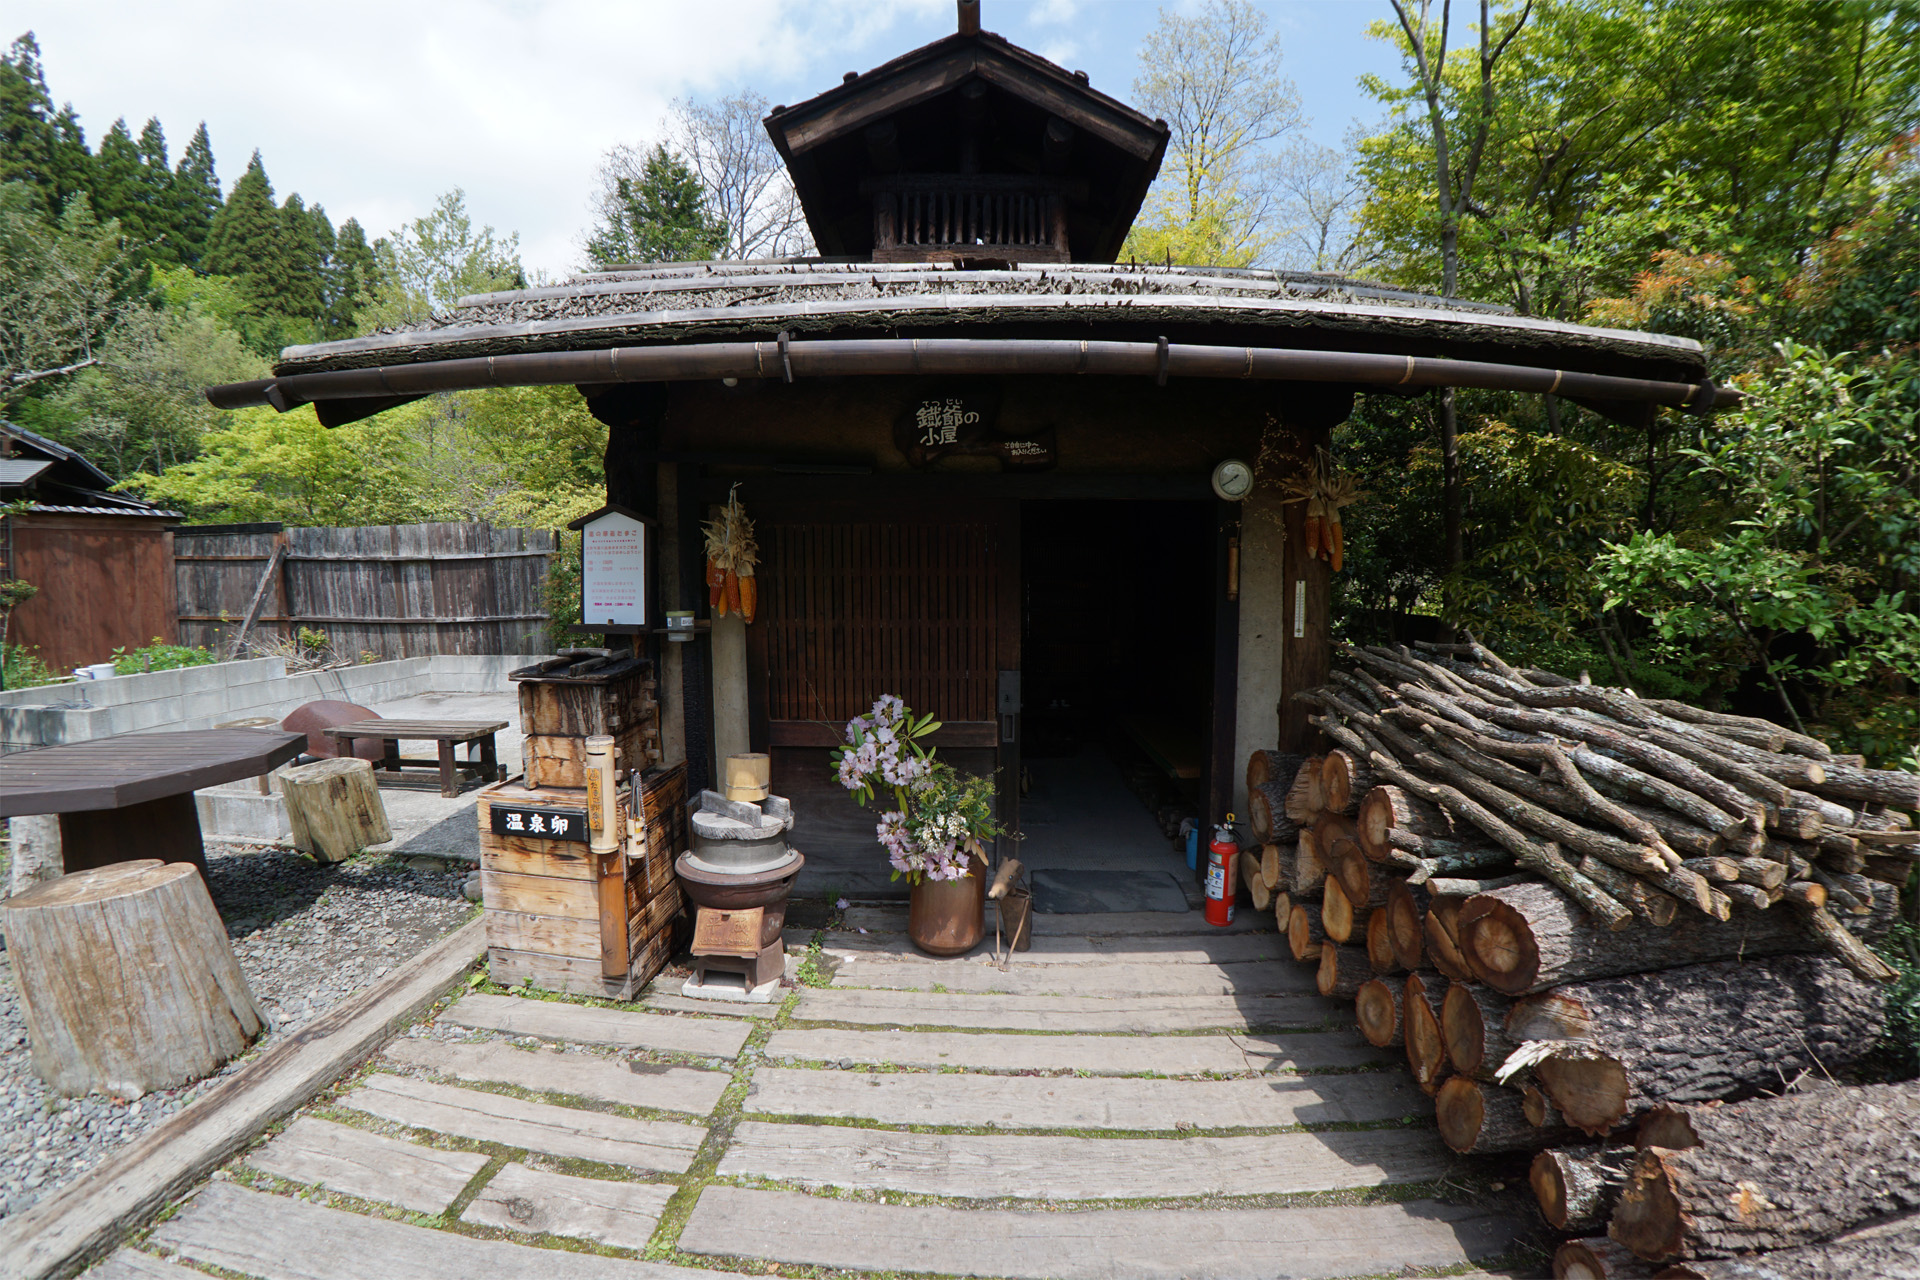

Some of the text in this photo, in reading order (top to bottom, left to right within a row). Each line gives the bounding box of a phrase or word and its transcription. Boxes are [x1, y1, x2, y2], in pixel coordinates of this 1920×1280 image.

[919, 426, 958, 446] 小屋
[505, 813, 569, 835] 温泉卵
